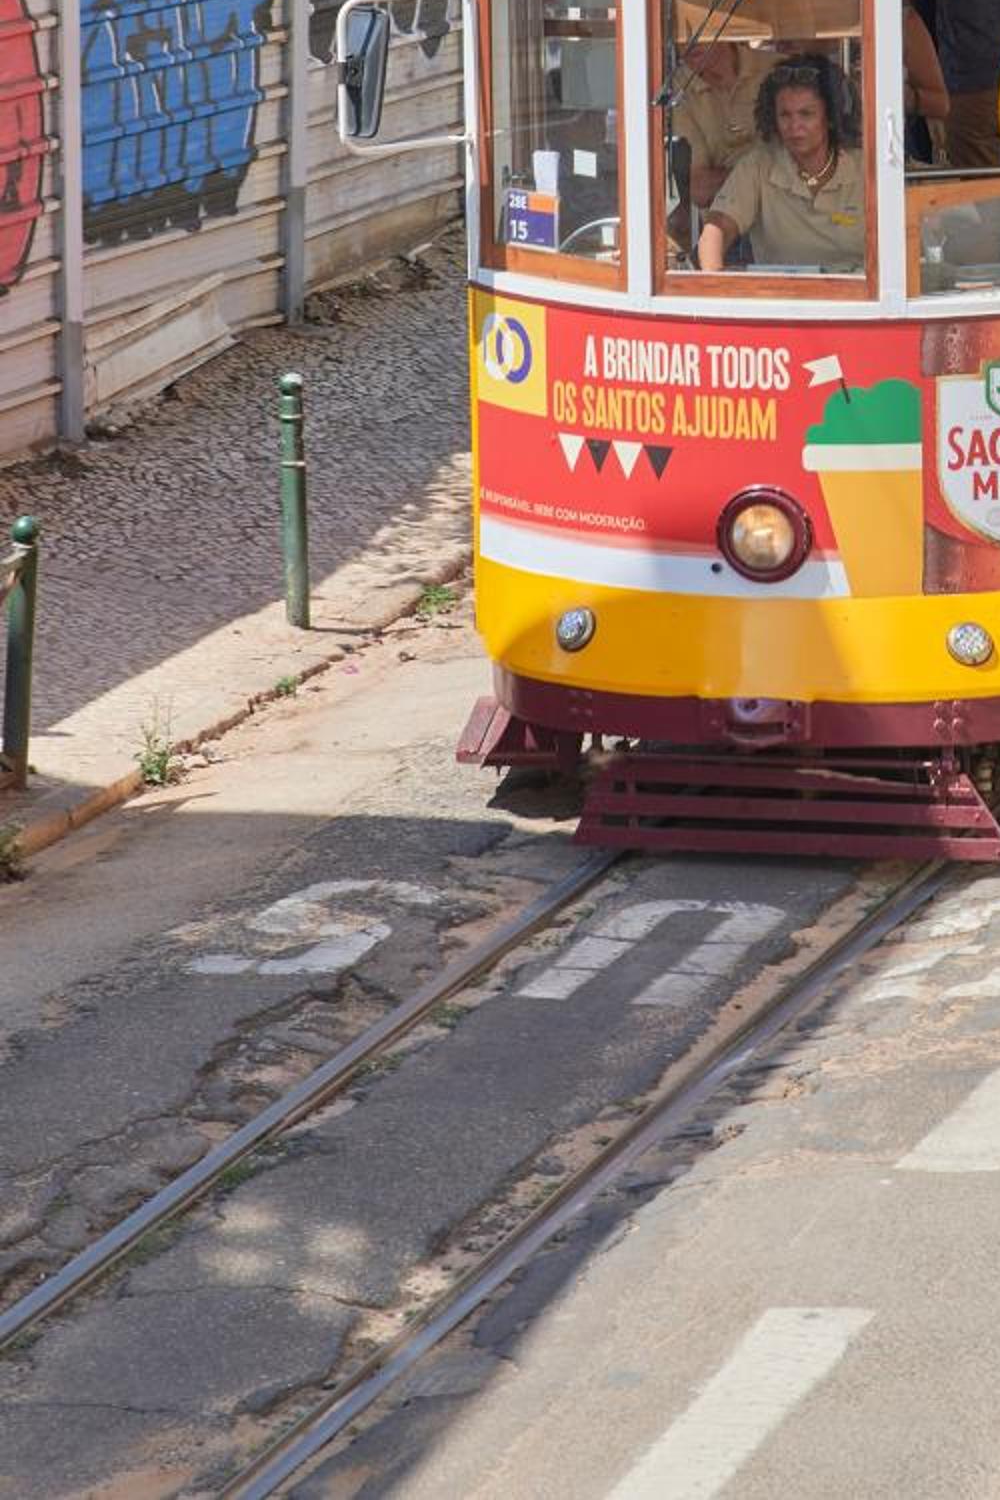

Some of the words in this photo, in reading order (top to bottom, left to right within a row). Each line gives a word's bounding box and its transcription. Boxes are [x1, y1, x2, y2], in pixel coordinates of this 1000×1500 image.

[509, 194, 528, 210] 28E
[509, 219, 529, 240] 15
[584, 334, 598, 378] A
[603, 336, 700, 387] BRINDAR
[706, 345, 791, 391] TODOS
[553, 380, 577, 424] OS
[582, 385, 666, 435] SANTOS
[672, 393, 778, 442] AJUDAM
[555, 506, 578, 521] COM
